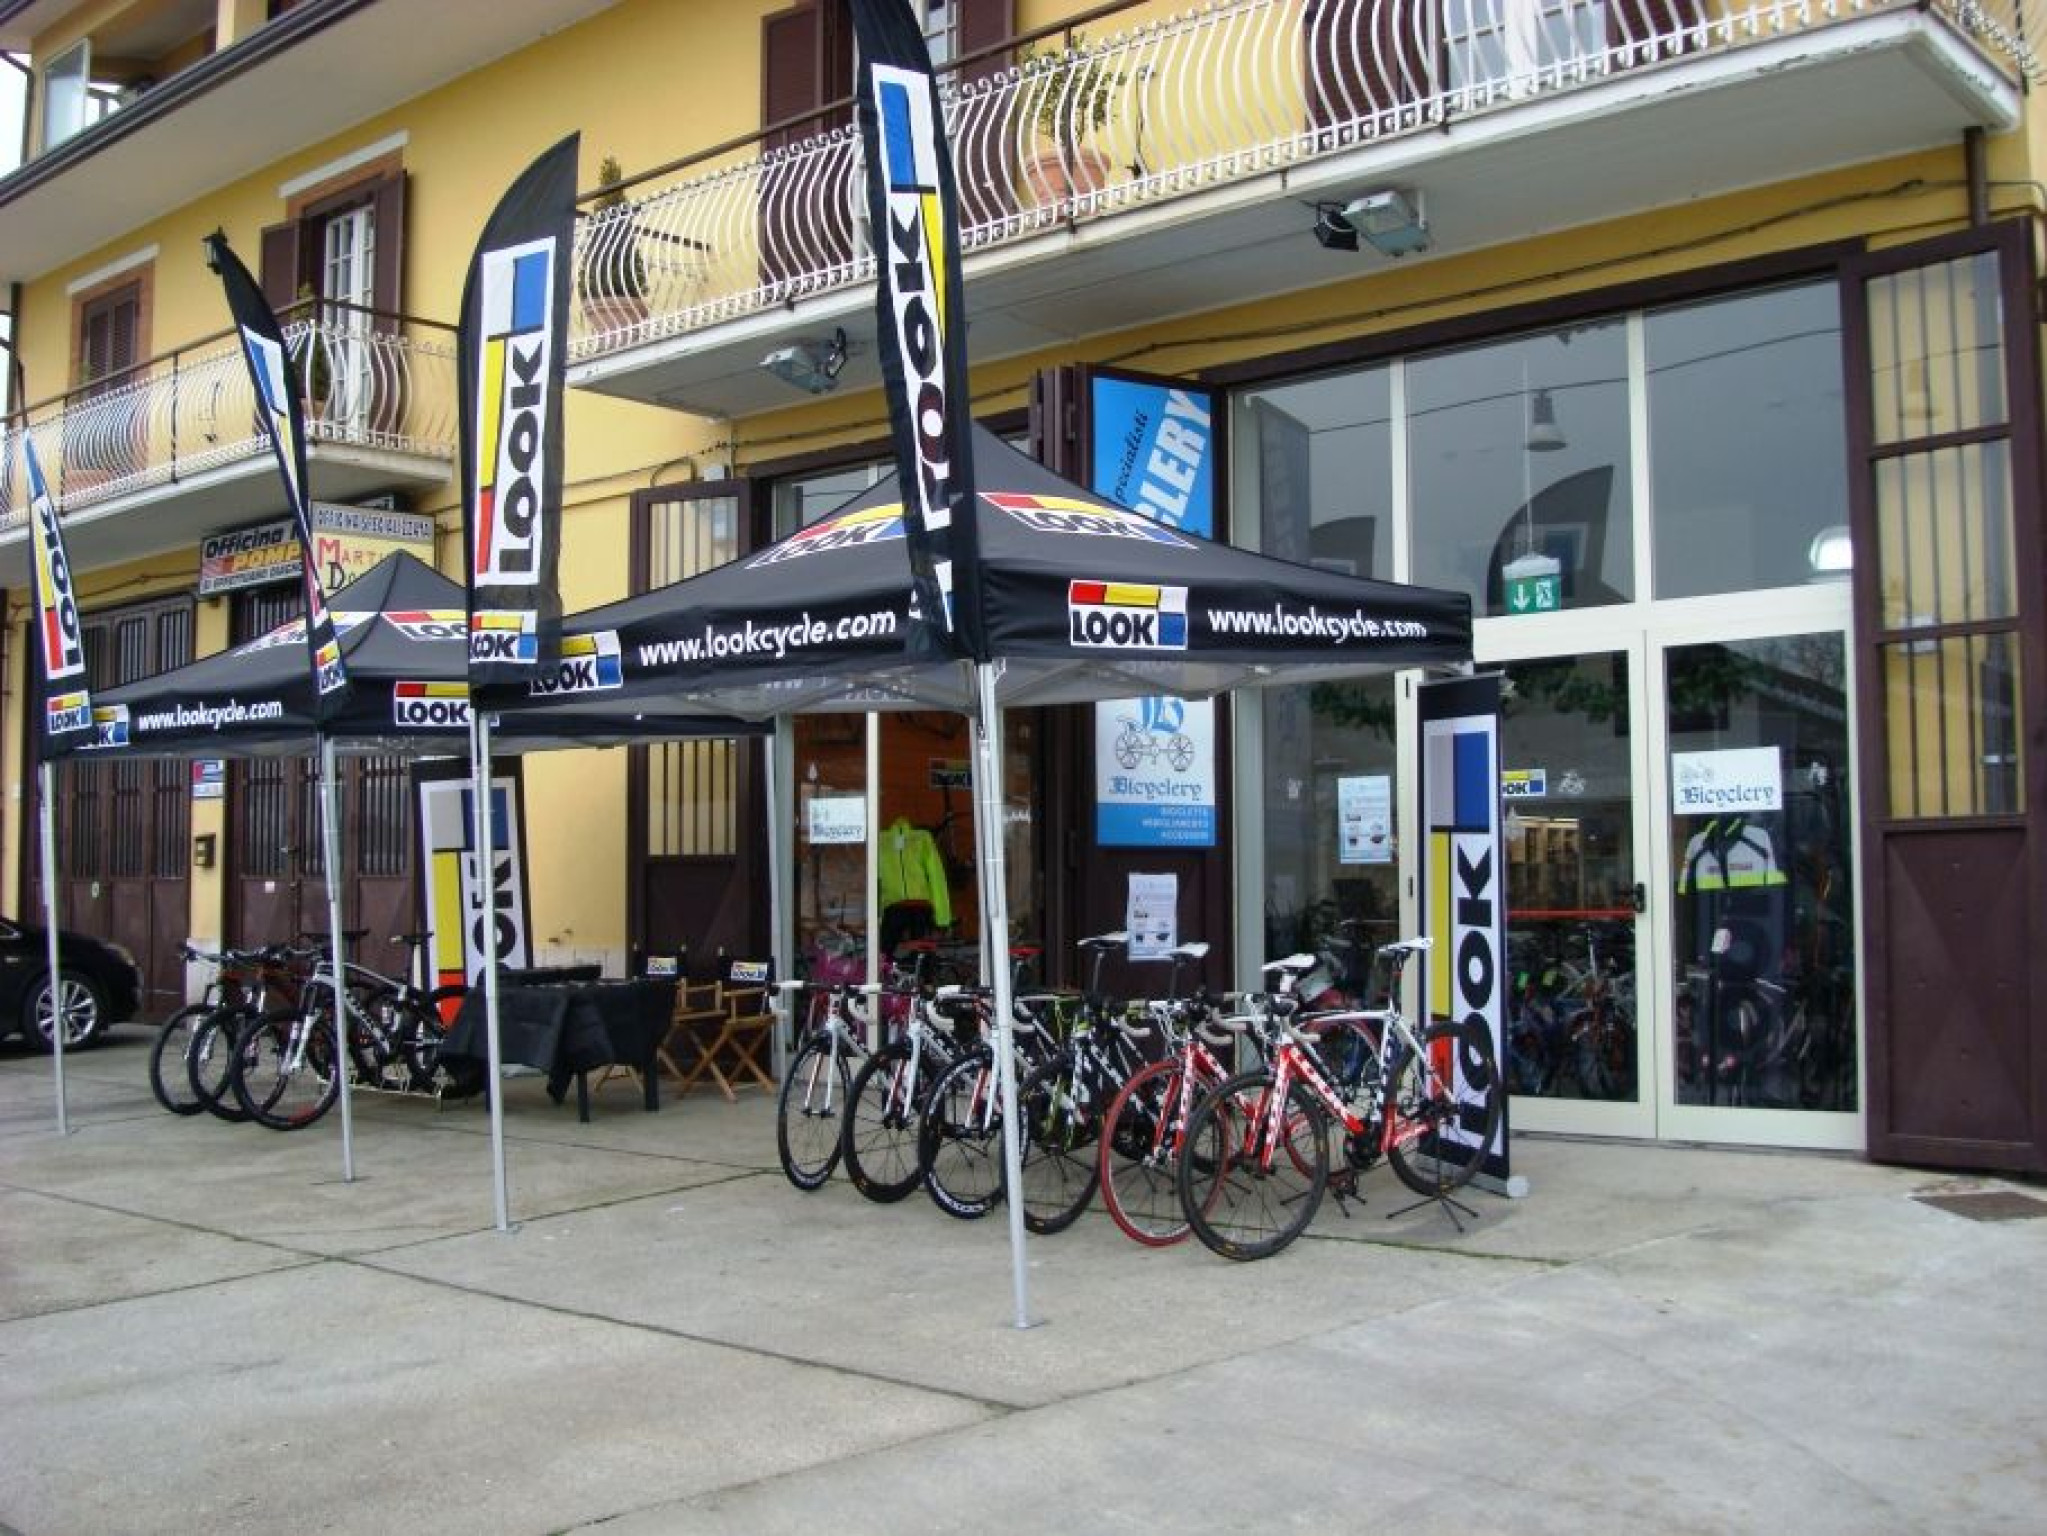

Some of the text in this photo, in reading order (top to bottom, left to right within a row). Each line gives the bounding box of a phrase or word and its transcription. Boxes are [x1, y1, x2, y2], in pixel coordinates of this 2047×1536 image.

[500, 339, 543, 572] LOOK
[1115, 407, 1148, 503] pecialisti
[1012, 510, 1144, 538] LOOK
[205, 527, 284, 559] Officina
[233, 545, 302, 571] POMP
[40, 506, 81, 667] LOOK
[640, 611, 896, 666] www.lookcycle.com
[1071, 611, 1155, 645] LOOK
[1207, 603, 1427, 643] www.lookcycle.com
[50, 709, 80, 731] LOOK
[138, 699, 282, 730] www.lookcycle.com
[398, 701, 469, 725] LOOK
[1457, 843, 1495, 1137] LOOK
